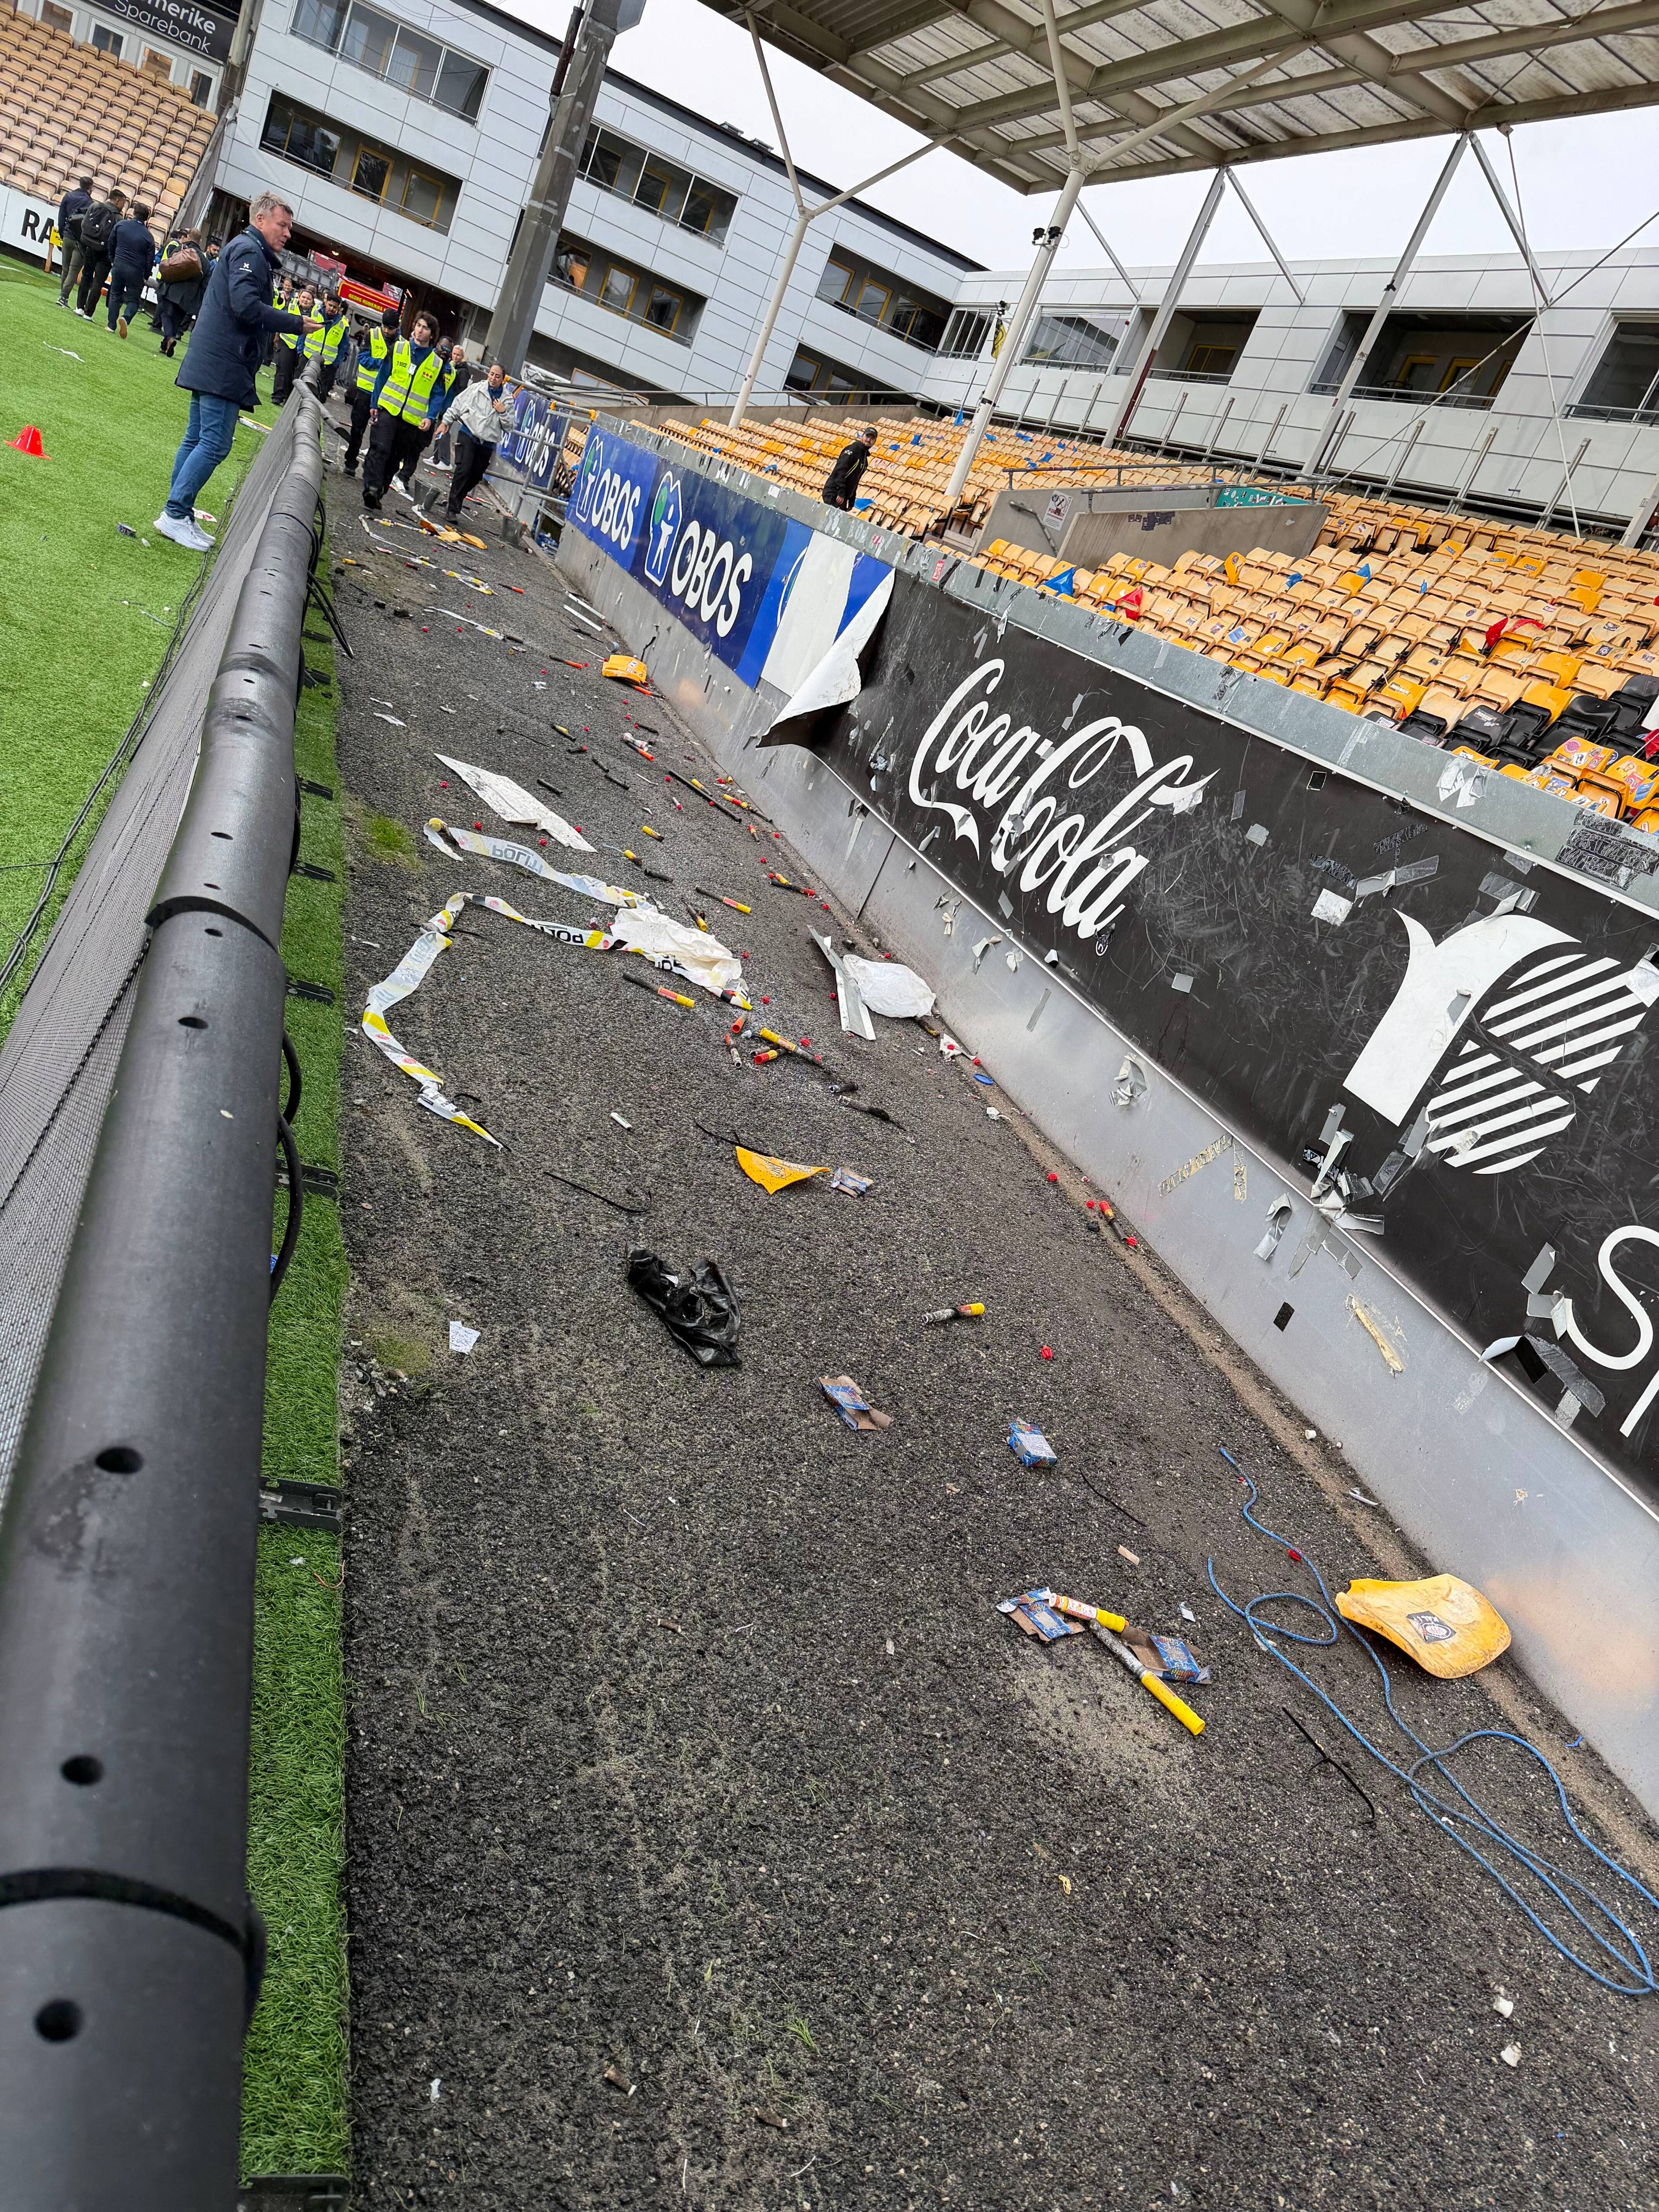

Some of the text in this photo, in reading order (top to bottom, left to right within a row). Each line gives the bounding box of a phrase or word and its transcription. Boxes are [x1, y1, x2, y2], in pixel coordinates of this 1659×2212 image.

[114, 0, 211, 54] Sparebank
[21, 208, 54, 244] RA
[591, 468, 640, 550] OBOS
[671, 520, 753, 638] OBOS
[909, 658, 1220, 939] Coca-Cola
